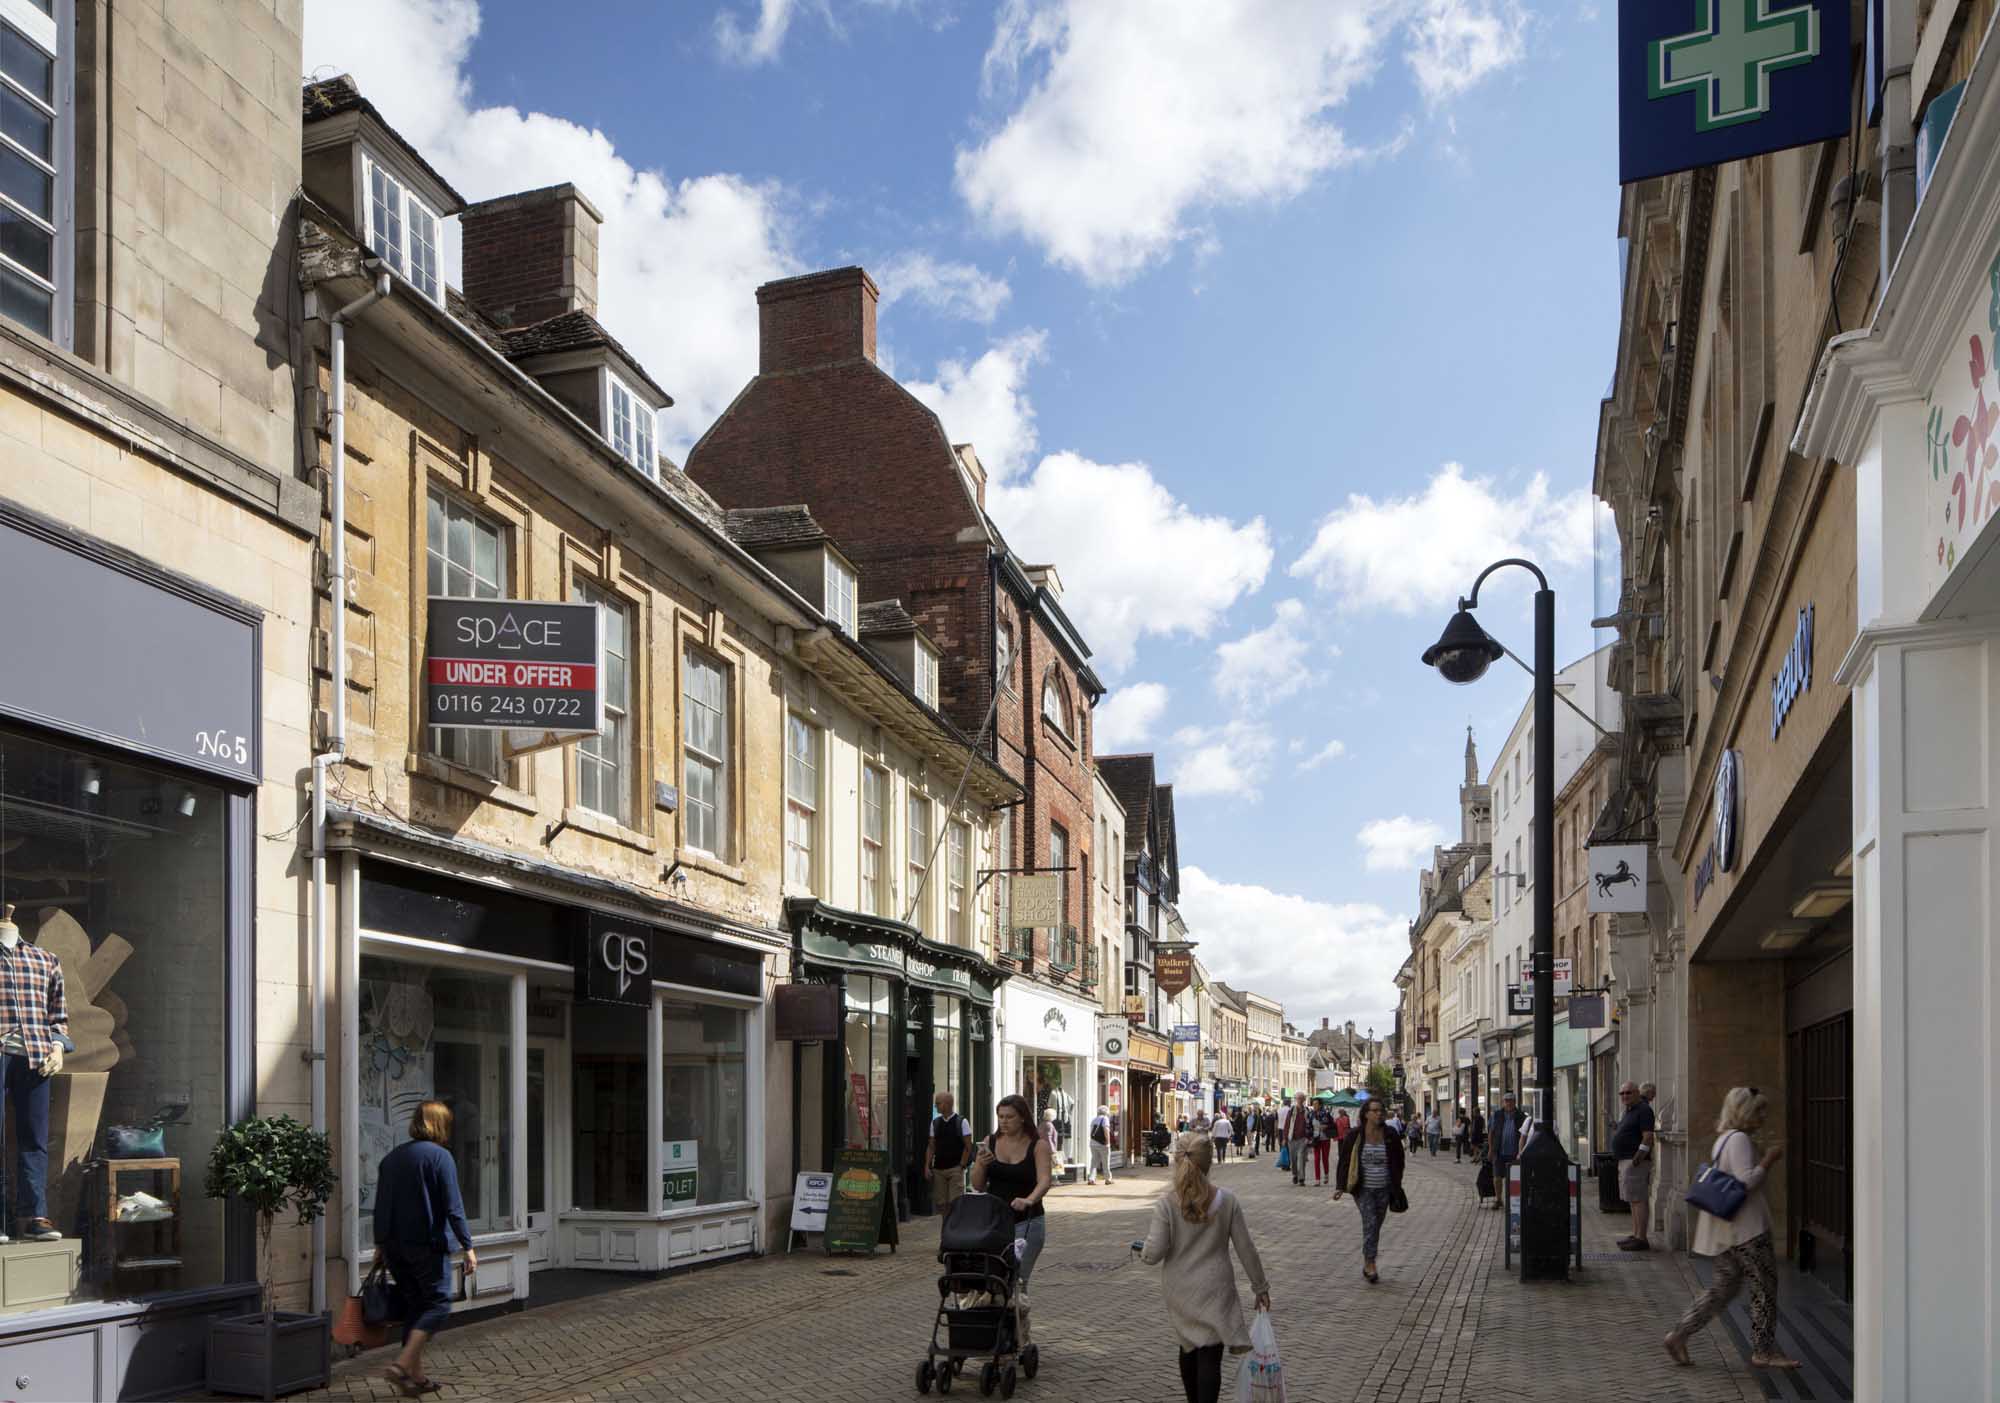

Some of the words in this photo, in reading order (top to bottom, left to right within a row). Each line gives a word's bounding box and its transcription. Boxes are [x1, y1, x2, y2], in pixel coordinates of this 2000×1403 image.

[446, 662, 507, 685] UNDER
[514, 665, 573, 687] OFFER
[437, 694, 483, 712] 0116
[490, 696, 526, 714] 243
[533, 698, 581, 716] 0722
[234, 736, 247, 764] 5
[1015, 897, 1056, 910] COOK
[1015, 910, 1056, 921] SHOP
[1553, 970, 1571, 980] ET
[676, 1179, 694, 1194] LET
